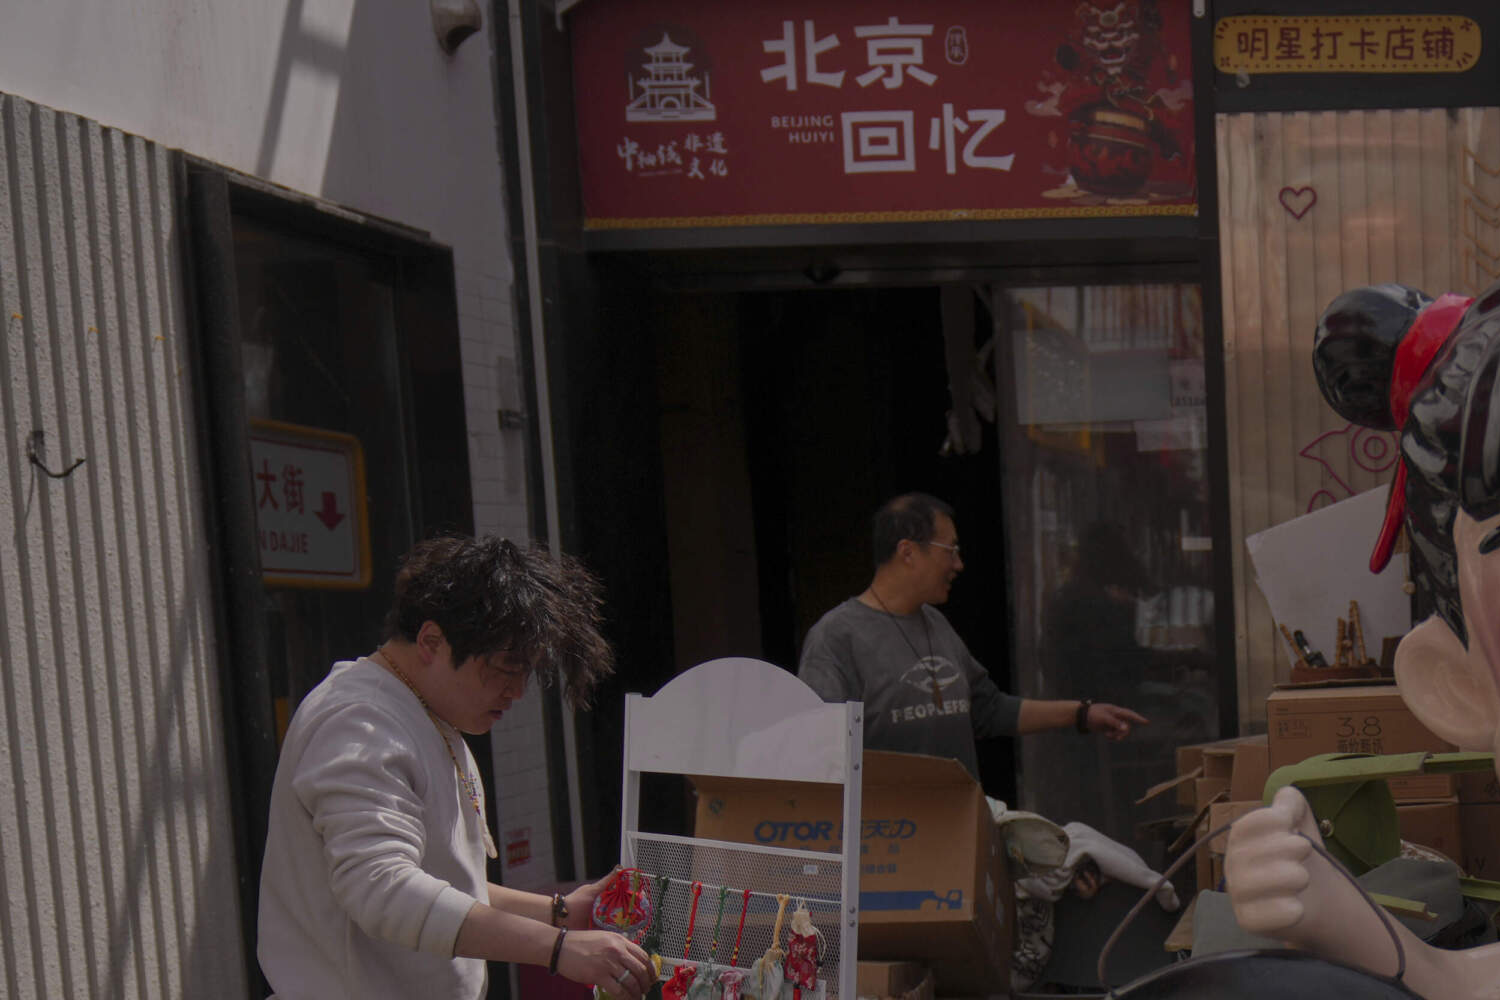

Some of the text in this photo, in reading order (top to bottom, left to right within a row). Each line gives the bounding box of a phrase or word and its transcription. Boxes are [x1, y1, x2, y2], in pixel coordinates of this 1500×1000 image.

[760, 16, 938, 91] 北京
[1236, 26, 1456, 62] 明星打卡店铺
[771, 114, 834, 129] BEIJING
[788, 130, 835, 144] HUIYI
[841, 103, 1016, 175] 回忆
[686, 156, 729, 180] 文化
[256, 458, 305, 517] 大街
[270, 530, 309, 554] DAJIE
[1336, 716, 1383, 738] 3.8
[754, 820, 834, 842] OTOR
